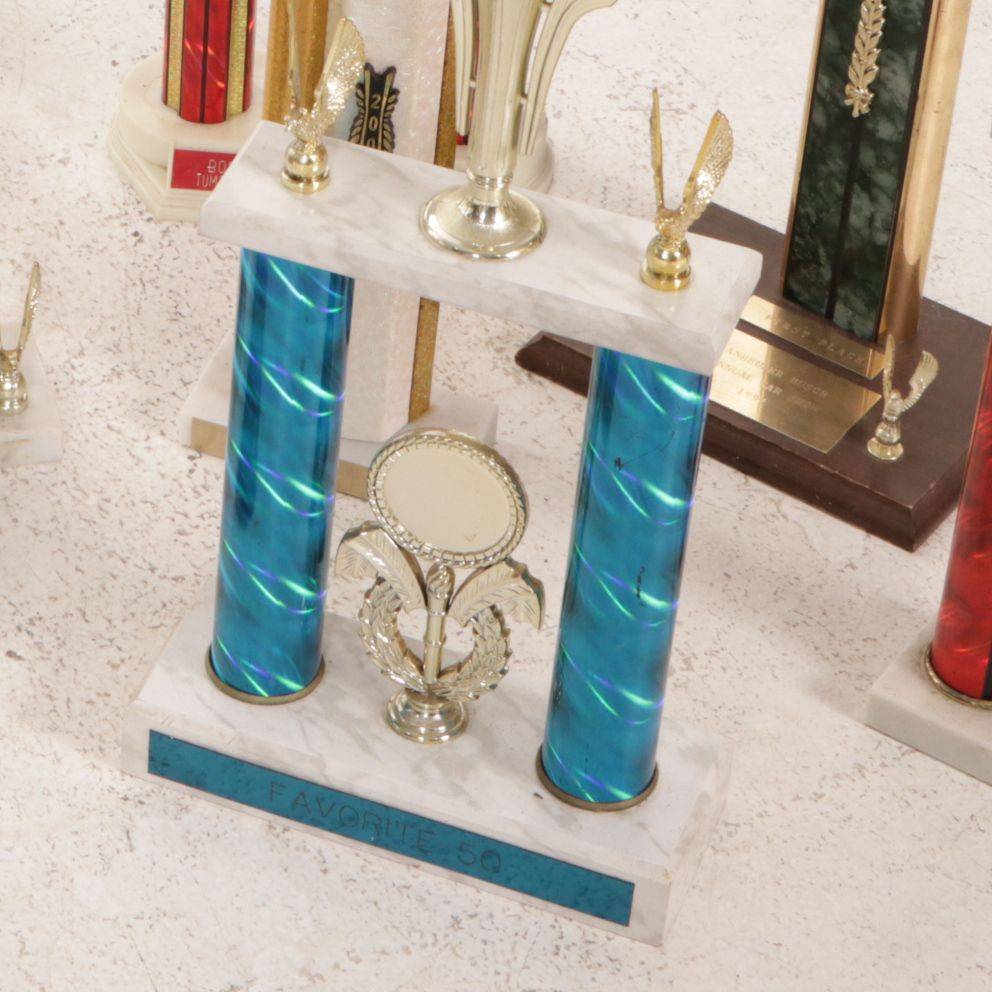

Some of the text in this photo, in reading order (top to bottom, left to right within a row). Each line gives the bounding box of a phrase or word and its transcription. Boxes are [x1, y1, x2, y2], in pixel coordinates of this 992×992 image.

[366, 92, 381, 147] 200
[207, 159, 230, 174] BO
[196, 173, 221, 188] TUM
[818, 338, 866, 364] PLACE
[719, 360, 753, 383] NNUAL
[269, 781, 502, 873] FAVORITE 50
